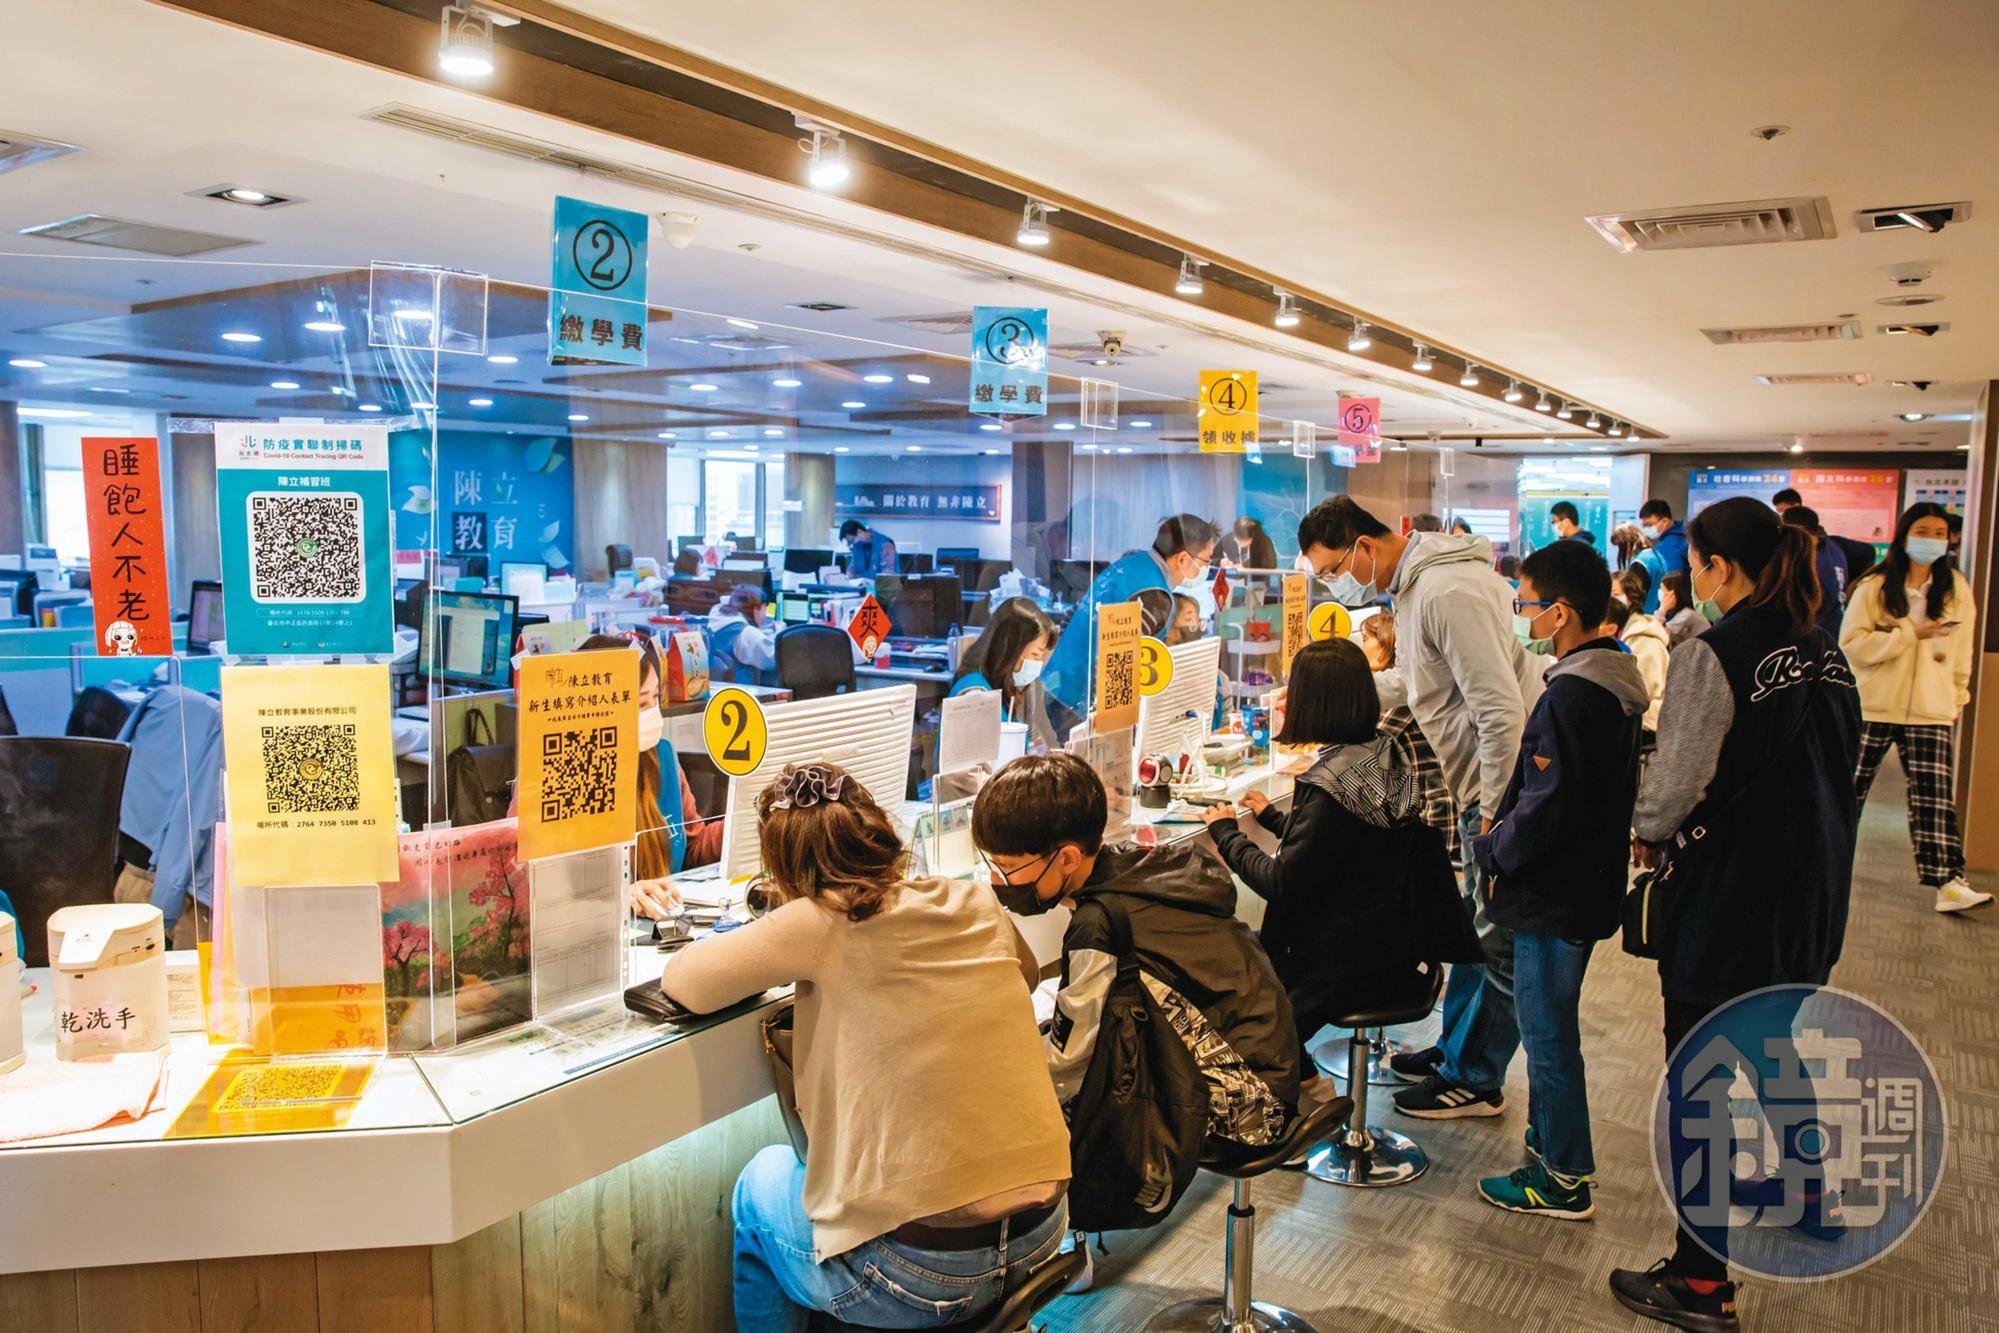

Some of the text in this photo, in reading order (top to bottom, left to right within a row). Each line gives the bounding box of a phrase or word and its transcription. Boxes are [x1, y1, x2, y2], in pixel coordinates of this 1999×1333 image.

[559, 314, 643, 352] 繳學費
[974, 383, 1042, 404] 繳學費
[263, 438, 363, 451] 防疫實聯制掃碼
[277, 476, 331, 487] 陳立補習班
[453, 469, 518, 506] 陳立
[103, 443, 150, 621] 睡飽人不老
[455, 515, 518, 550] 教育
[859, 601, 880, 639] 爽
[1319, 610, 1340, 638] 4
[1140, 646, 1159, 687] 3
[257, 706, 358, 717] 陳立教育事業股份有限公司
[528, 690, 631, 713] 新生填寫介紹人表單
[721, 699, 751, 762] 2
[296, 820, 315, 828] 2764
[362, 818, 376, 826] 413
[61, 1007, 136, 1034] 乾洗手
